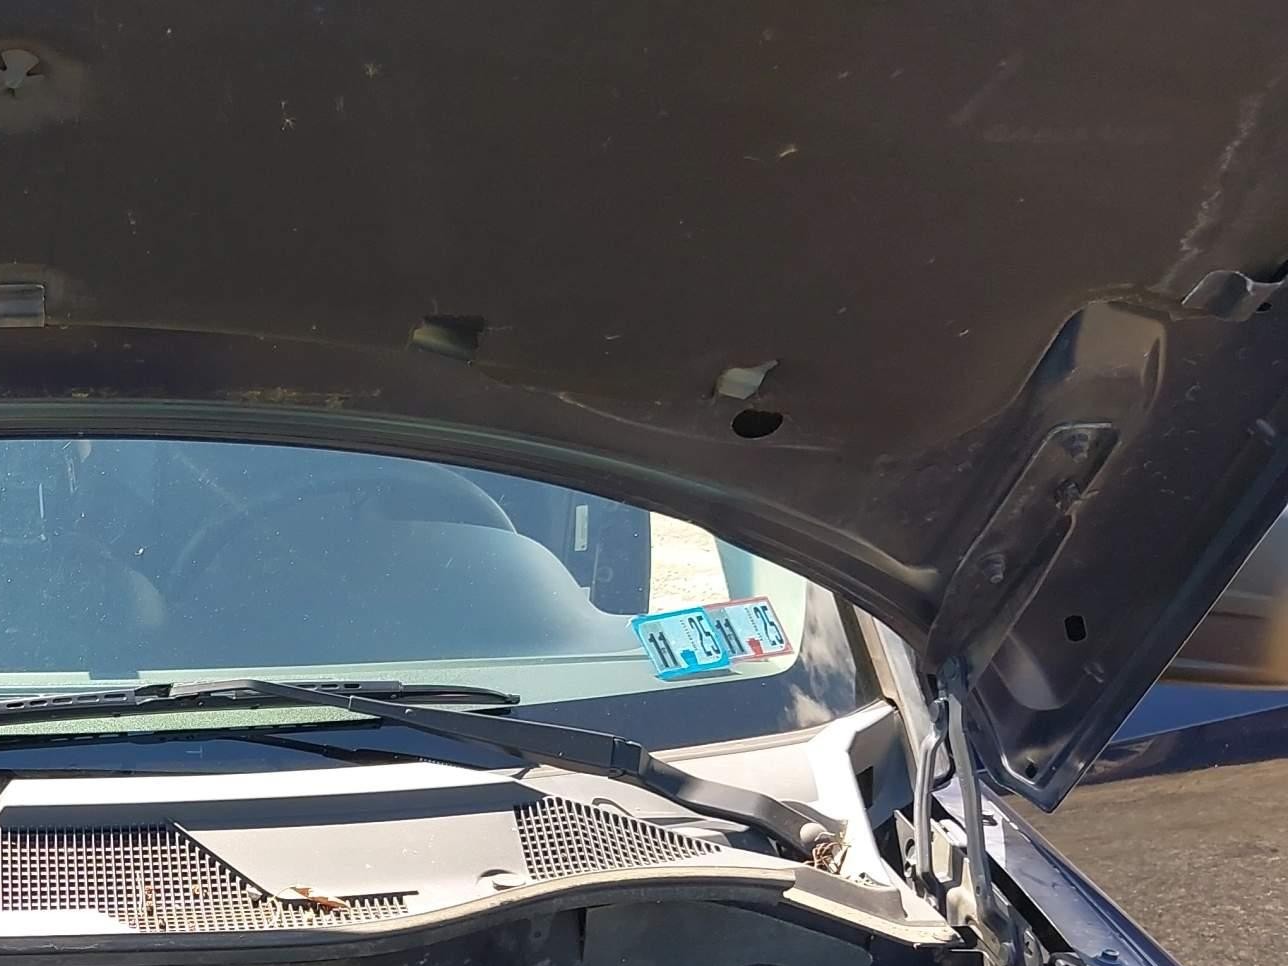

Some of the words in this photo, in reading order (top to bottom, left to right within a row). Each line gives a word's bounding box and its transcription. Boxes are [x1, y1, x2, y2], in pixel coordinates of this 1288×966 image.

[648, 632, 679, 668] 11
[688, 615, 721, 656] 25
[715, 618, 744, 654] 11
[753, 605, 784, 646] 25
